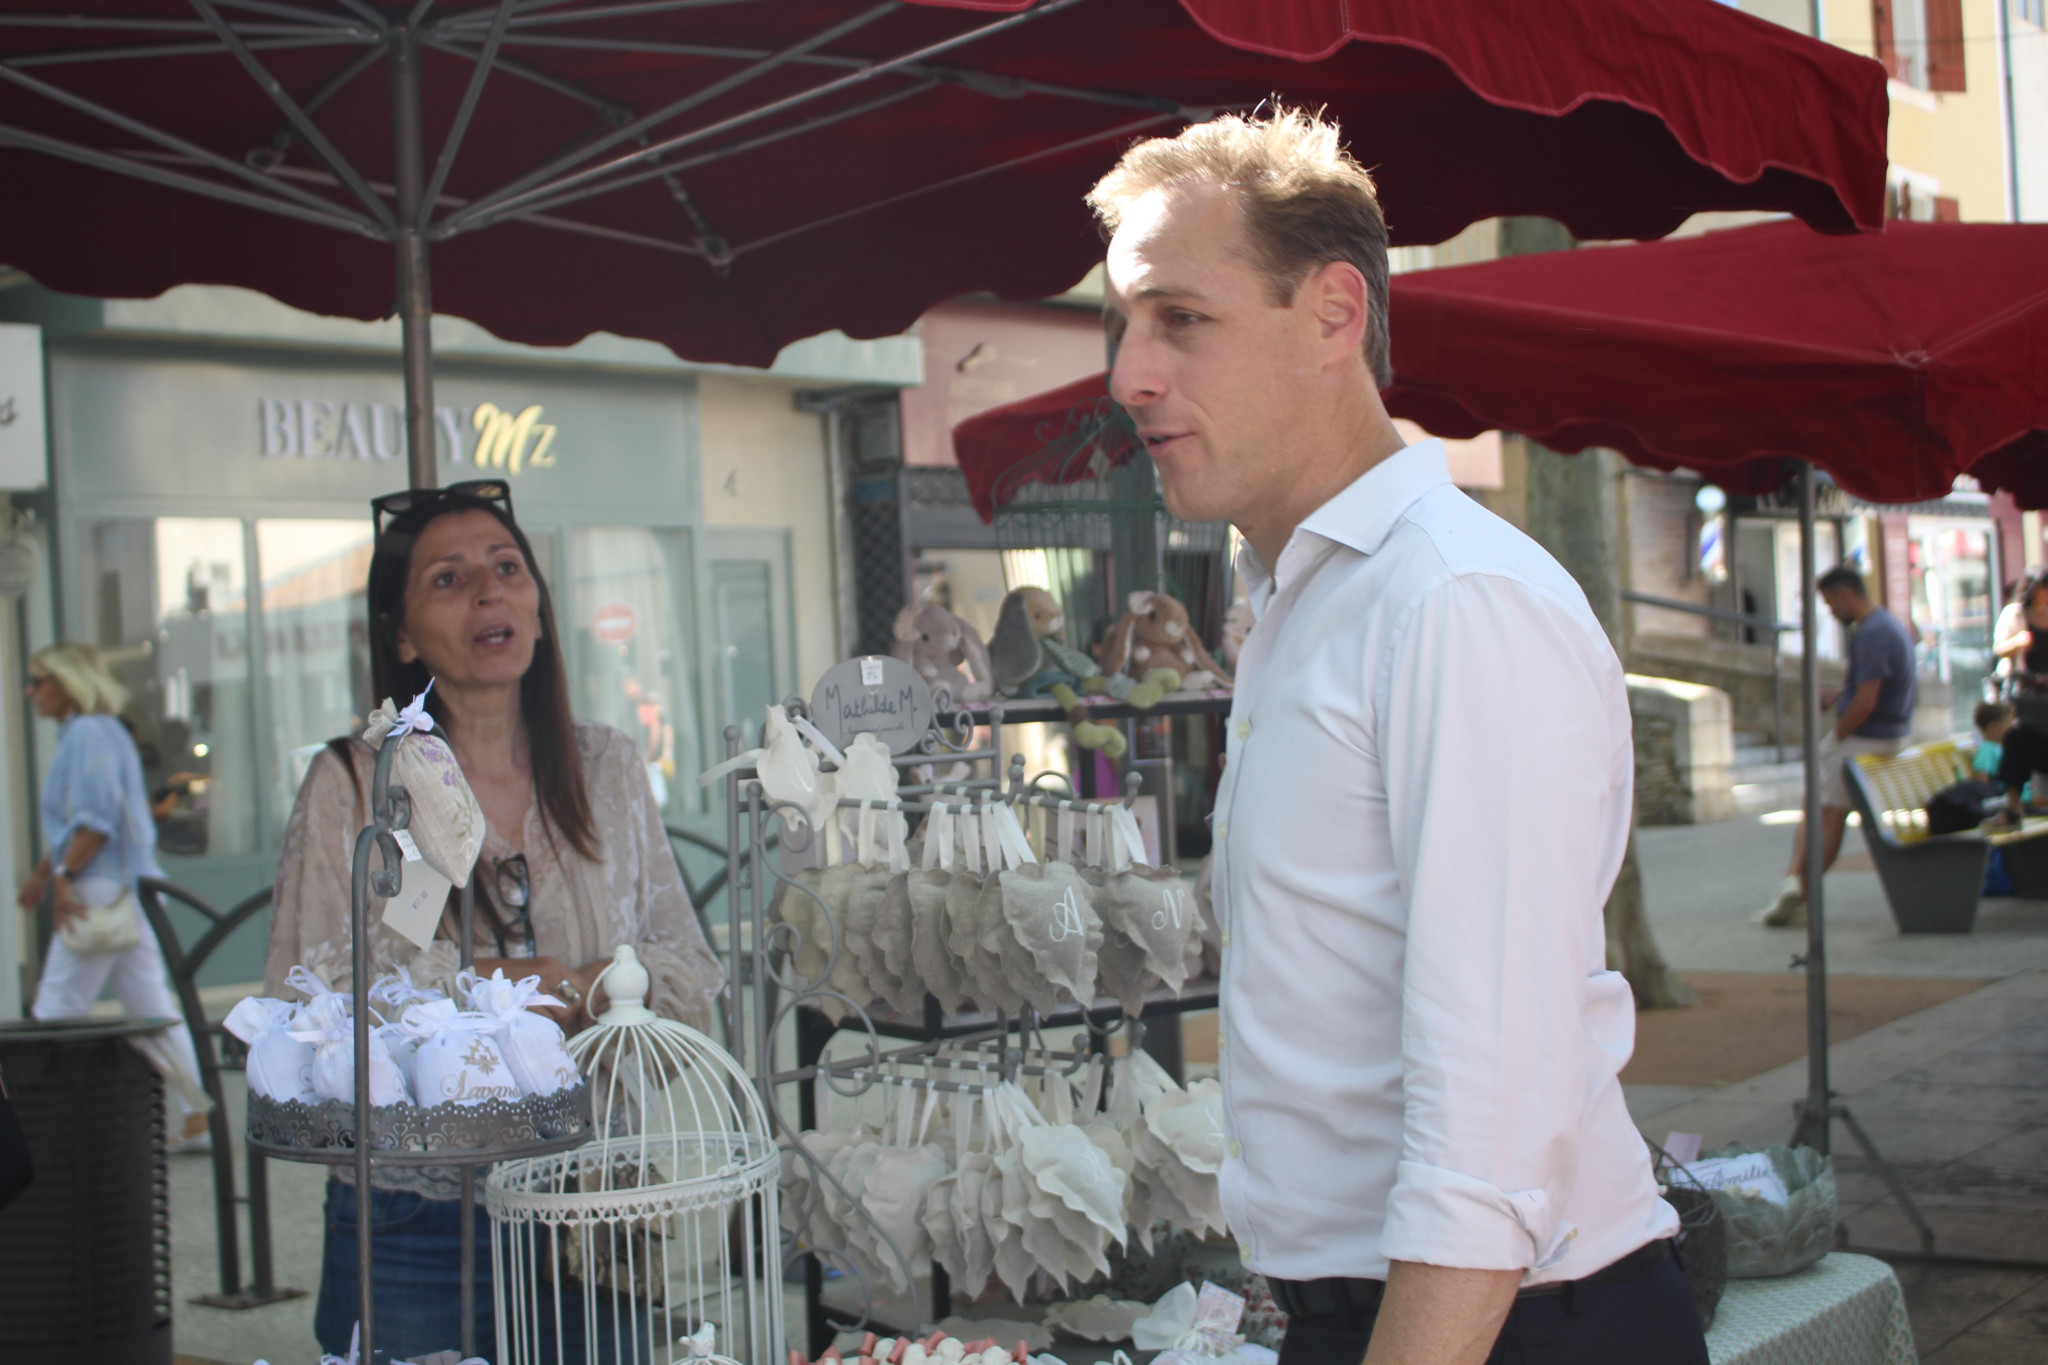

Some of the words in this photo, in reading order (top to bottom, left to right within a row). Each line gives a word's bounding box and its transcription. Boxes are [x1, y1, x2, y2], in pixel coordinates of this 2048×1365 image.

[257, 398, 470, 460] BEAUY
[825, 683, 896, 738] Mathilde
[1049, 886, 1084, 942] A
[1152, 889, 1185, 930] N
[441, 1070, 522, 1101] Lavand
